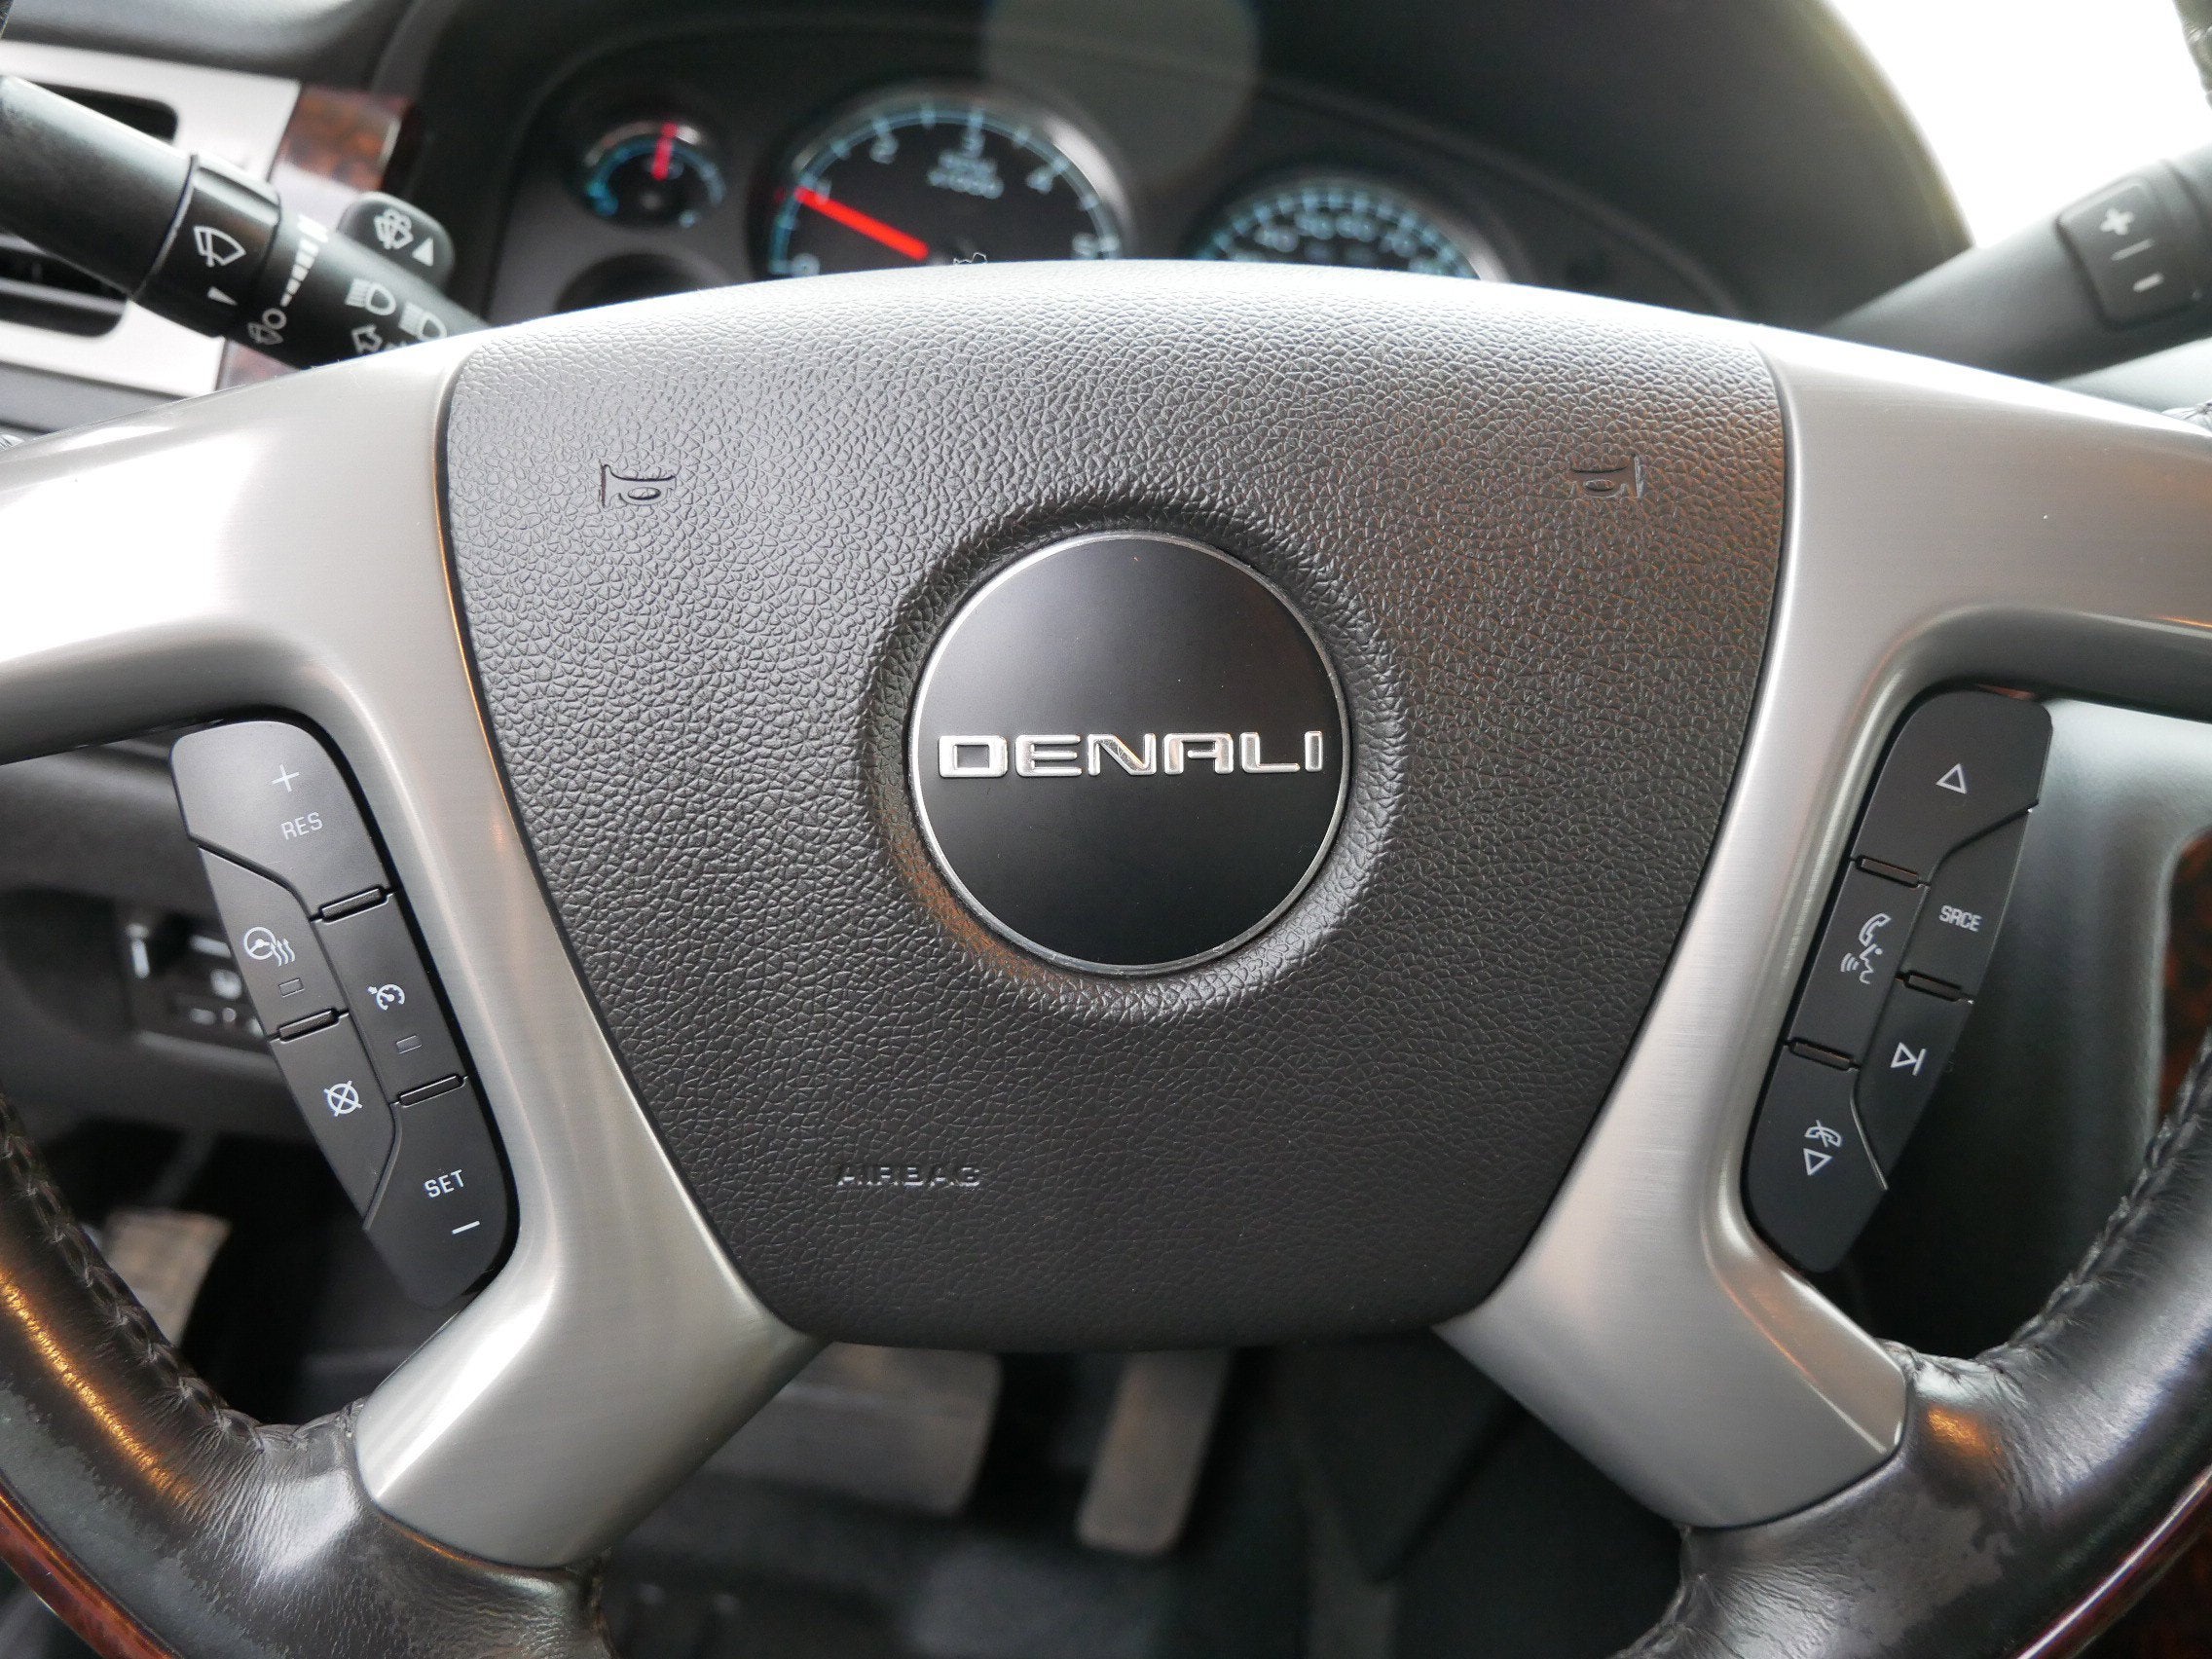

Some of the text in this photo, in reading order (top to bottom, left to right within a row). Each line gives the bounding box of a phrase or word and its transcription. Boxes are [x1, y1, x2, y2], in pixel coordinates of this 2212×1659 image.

[939, 731, 1323, 778] DENALI
[281, 811, 323, 840] RES
[1938, 904, 1982, 932] SRCE
[424, 1169, 466, 1198] SET
[837, 1166, 980, 1189] AIRBAG
